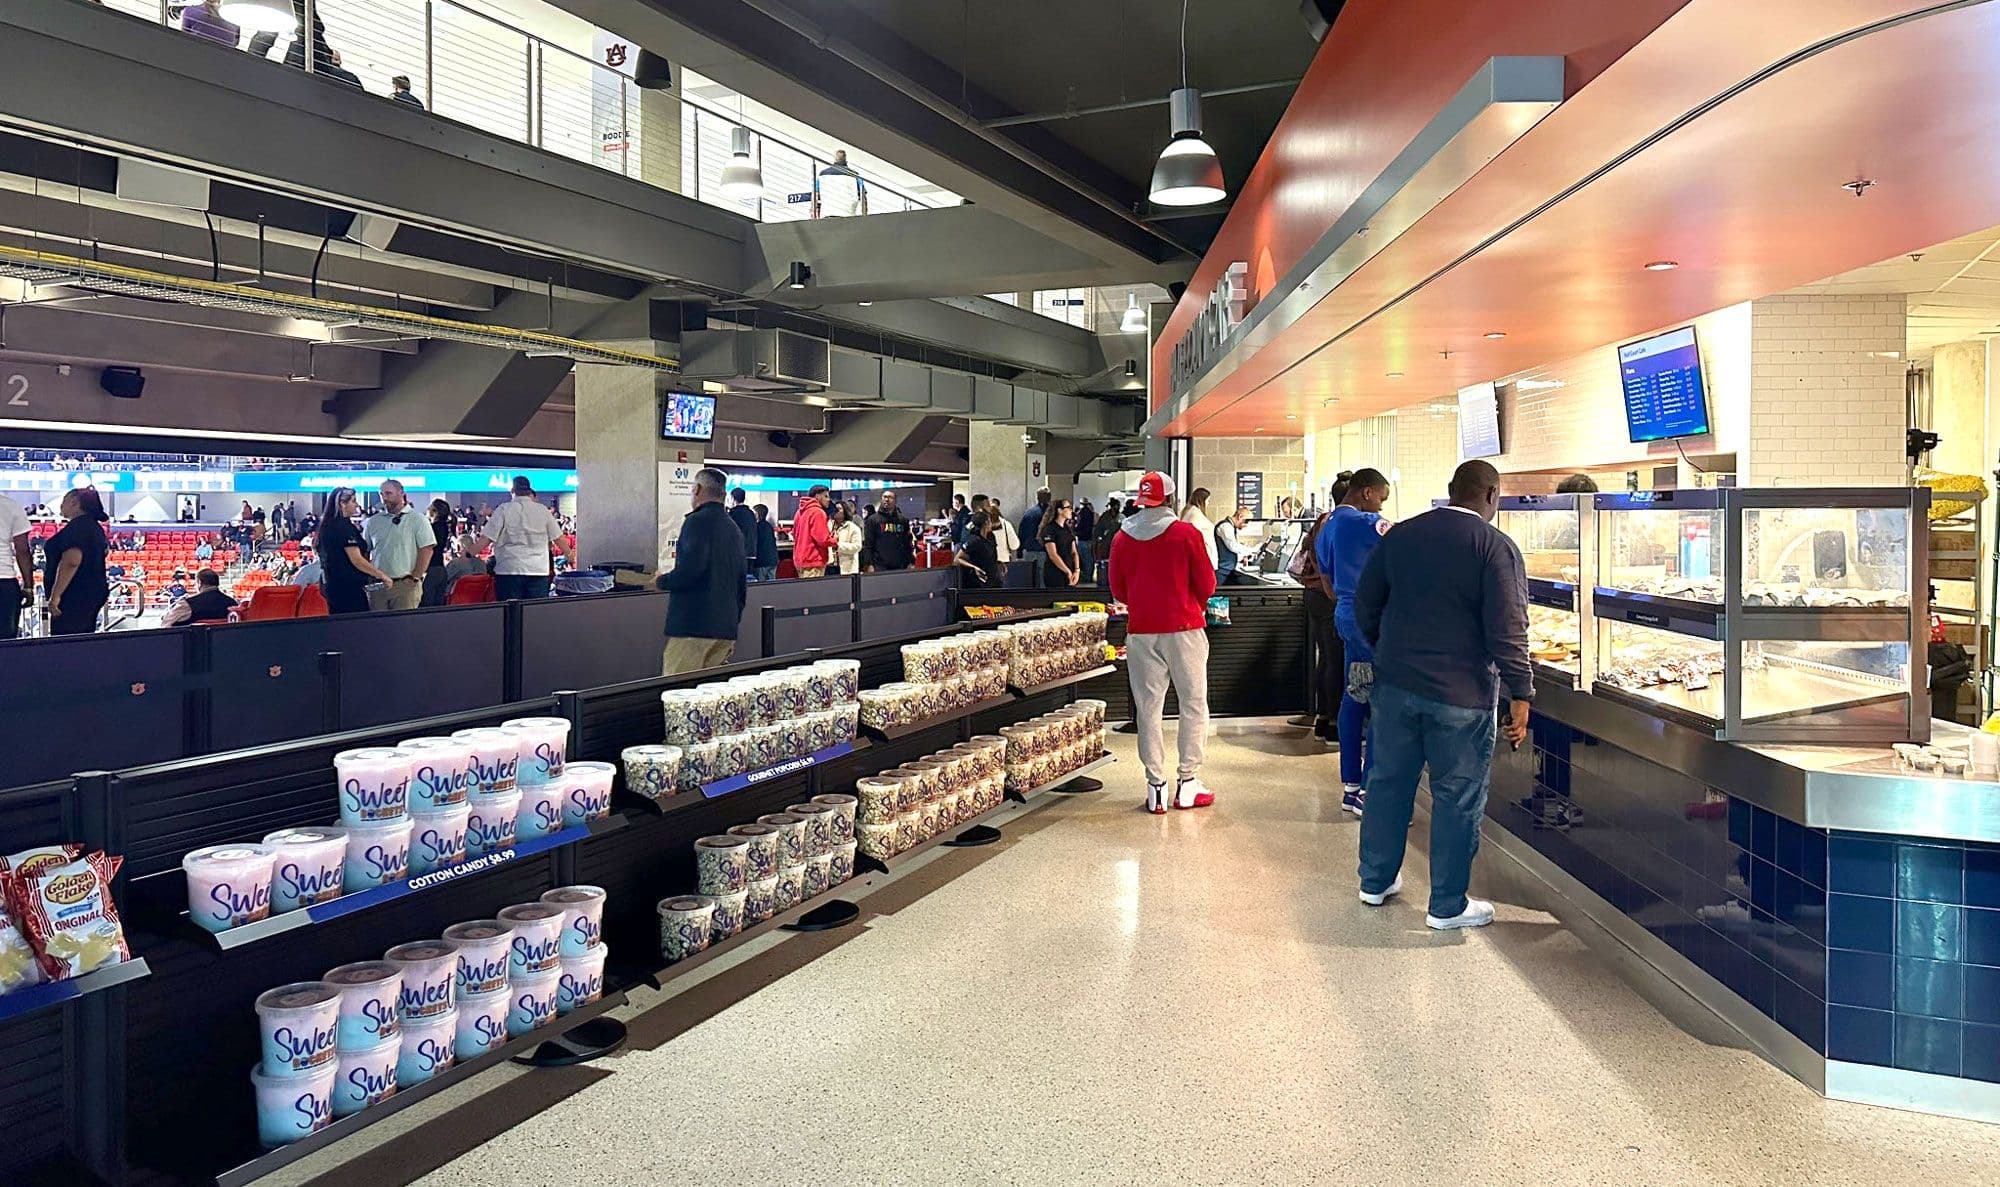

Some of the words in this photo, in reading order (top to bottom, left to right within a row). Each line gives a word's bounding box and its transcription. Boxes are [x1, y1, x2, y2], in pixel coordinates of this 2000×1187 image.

[7, 374, 29, 406] 2
[726, 435, 747, 454] 113
[417, 766, 468, 799] Swee
[467, 751, 519, 787] Sweet
[747, 768, 777, 783] GOURMET
[774, 760, 802, 774] POPCORN
[345, 776, 411, 813] Sweet
[467, 814, 517, 847] Swee
[364, 845, 408, 880] Swe
[408, 868, 455, 889] COTTON
[453, 857, 490, 876] CANDY
[488, 849, 516, 866] $8.99
[47, 873, 93, 895] Golden
[55, 881, 93, 902] Flake
[456, 950, 510, 987] Sweet
[274, 1017, 339, 1063] Sweet
